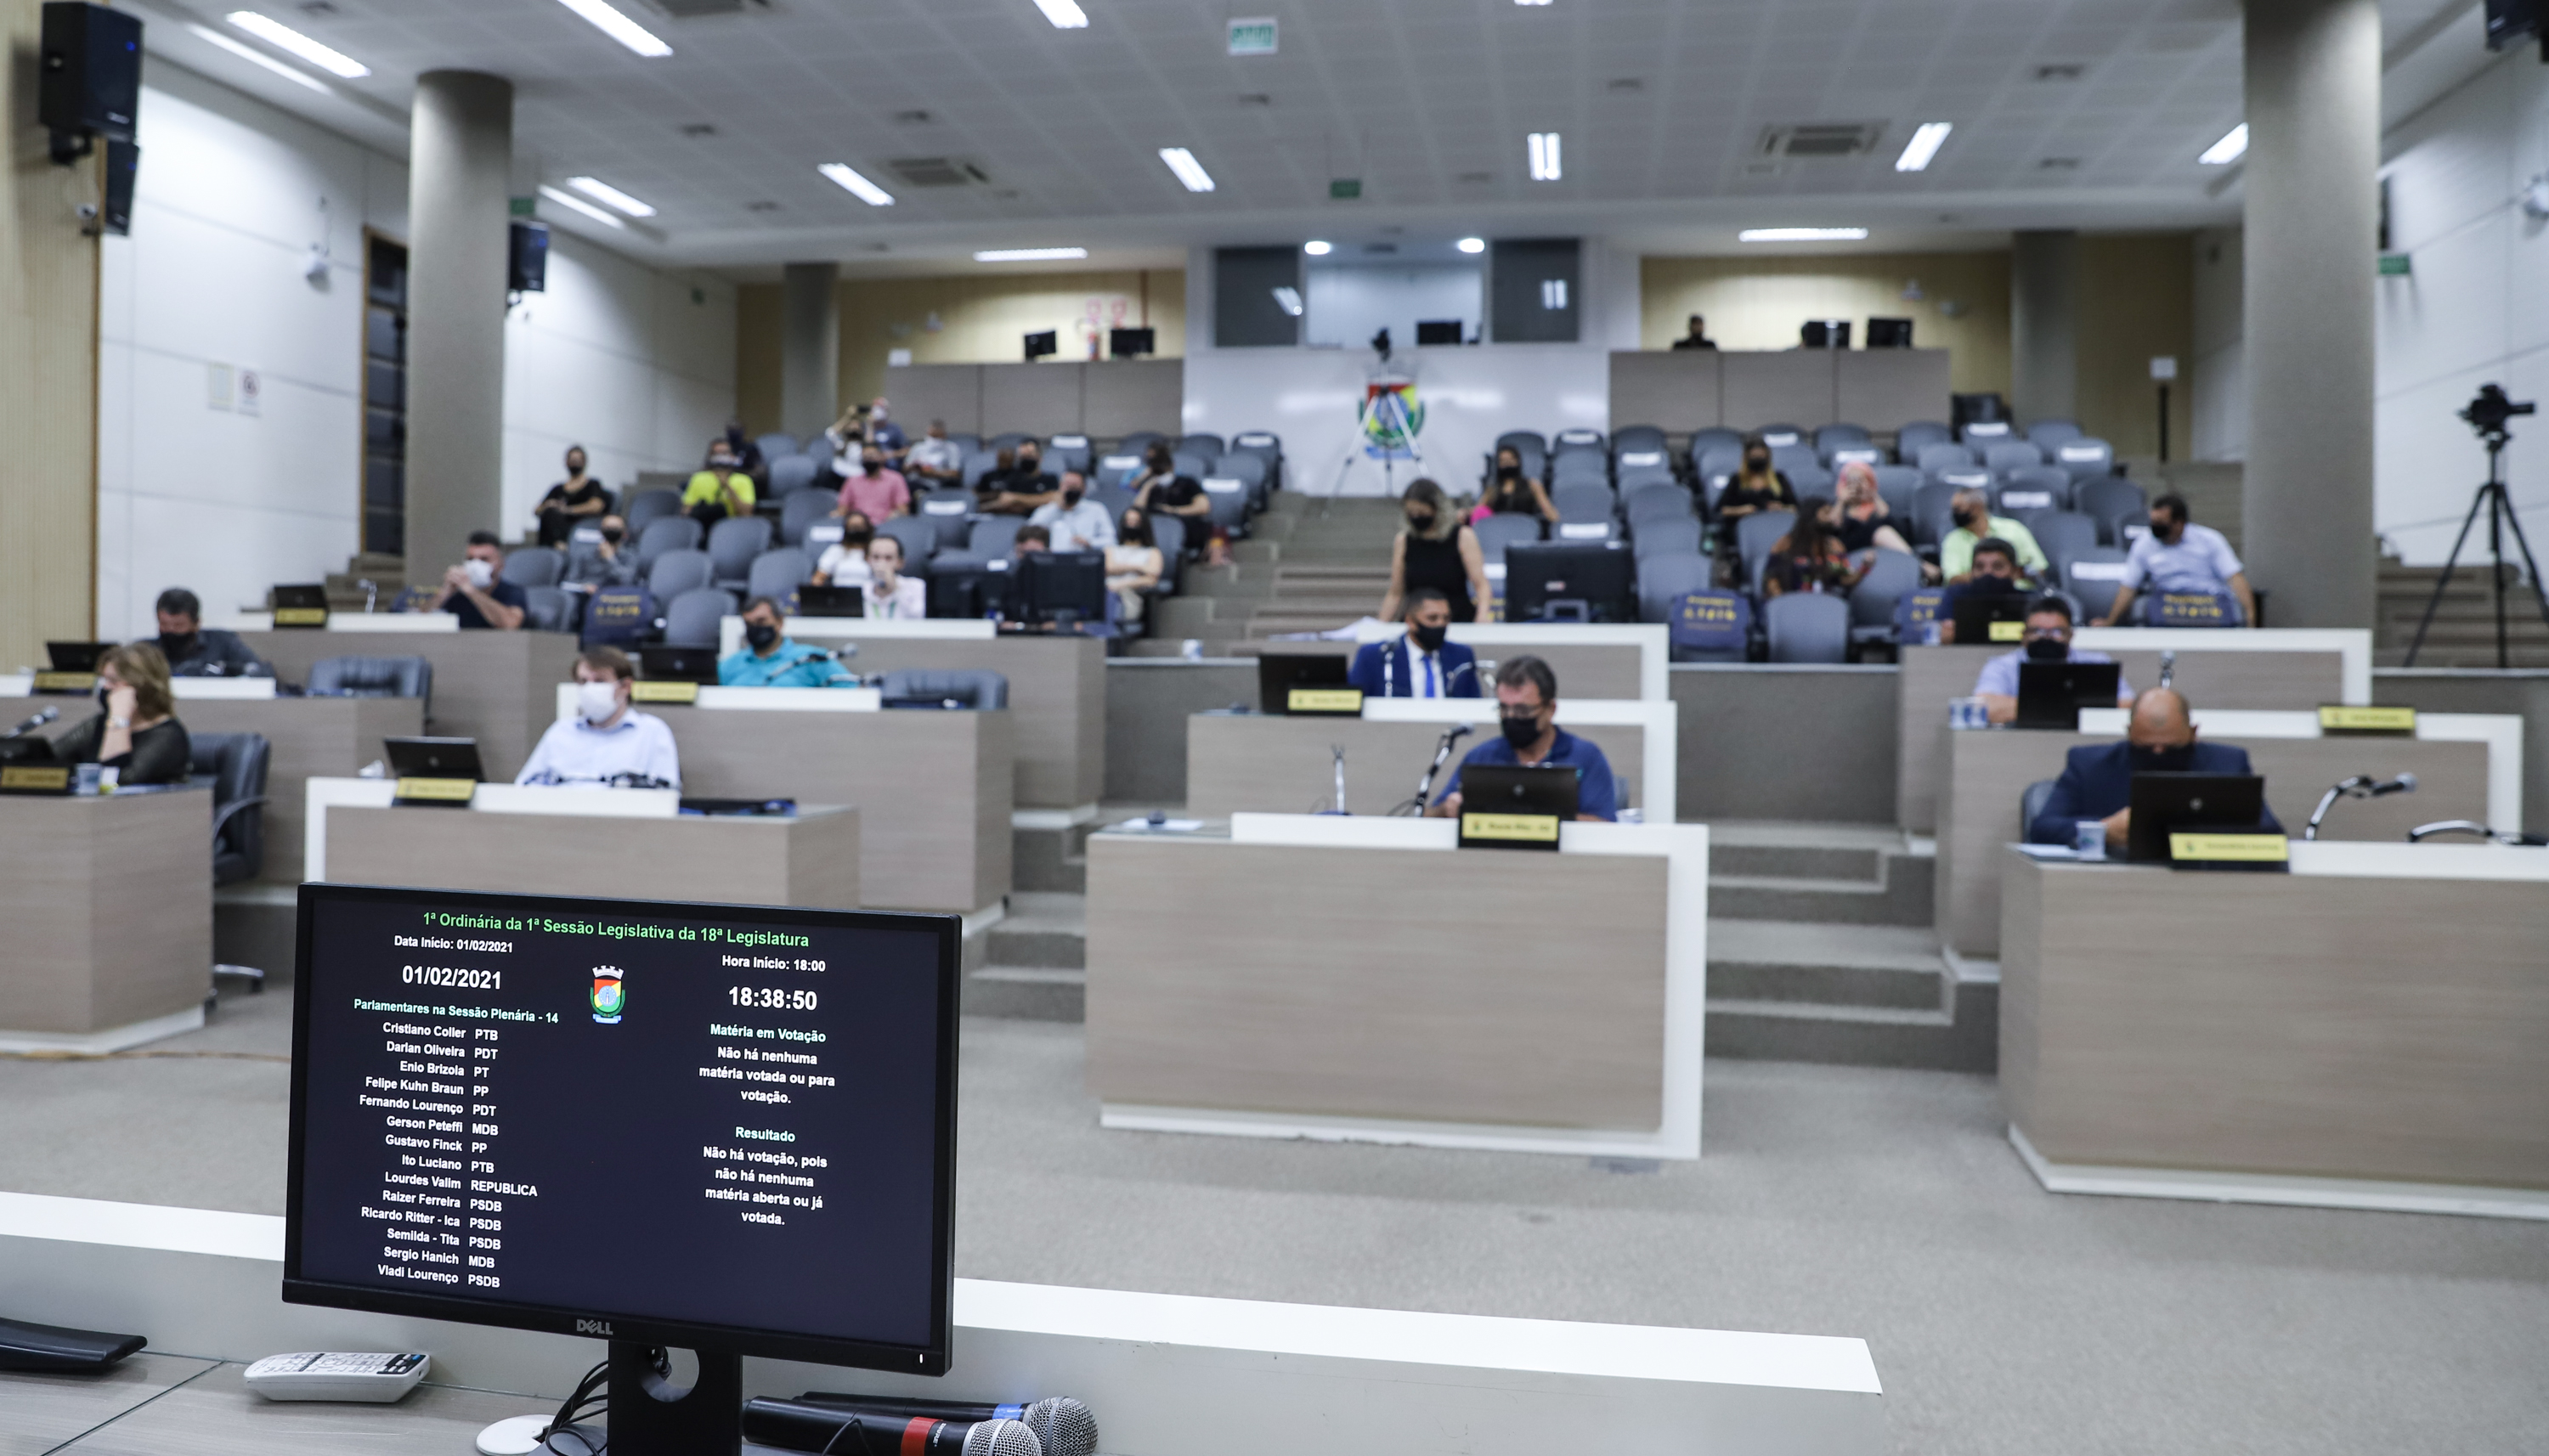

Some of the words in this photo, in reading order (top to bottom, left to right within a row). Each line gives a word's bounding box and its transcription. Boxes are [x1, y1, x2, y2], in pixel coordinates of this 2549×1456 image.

[424, 912, 436, 924] 1ª
[440, 913, 501, 928] Ordinária
[506, 917, 522, 930] da
[527, 918, 540, 931] 1ª
[544, 919, 594, 934] Sessão
[598, 922, 674, 939] Legislativa
[679, 927, 695, 940] da
[701, 928, 722, 941] 18ª
[727, 929, 808, 946] Legislatura
[394, 935, 418, 947] Data
[421, 936, 454, 949] Início:
[457, 940, 512, 952] 01/02/2021
[722, 955, 750, 968] Hora
[754, 957, 789, 969] Início:
[794, 959, 826, 972] 18:00
[403, 966, 500, 989] 01/02/2021
[729, 986, 817, 1010] 18:38:50
[354, 999, 429, 1013] Parlamentares
[432, 1007, 445, 1015] na
[449, 1006, 488, 1018] Sessão
[491, 1008, 534, 1021] Plenária
[545, 1013, 558, 1023] 14
[383, 1022, 431, 1036] Cristiano
[433, 1026, 466, 1038] Coller
[475, 1029, 498, 1041] PTB
[710, 1024, 753, 1037] Matéria
[756, 1030, 774, 1039] em
[778, 1029, 826, 1043] Votação
[387, 1041, 421, 1053] Darlan
[424, 1044, 465, 1057] Oliveira
[475, 1047, 498, 1059] PDT
[718, 1047, 741, 1058] Não
[744, 1048, 758, 1060] há
[762, 1052, 817, 1064] nenhuma
[400, 1061, 424, 1072] Enio
[427, 1063, 464, 1075] Brizola
[474, 1066, 489, 1078] PT
[699, 1066, 743, 1080] matéria
[746, 1070, 786, 1082] votada
[789, 1075, 805, 1084] ou
[808, 1075, 834, 1087] para
[365, 1076, 398, 1091] Felipe
[400, 1080, 428, 1092] Kuhn
[432, 1082, 464, 1095] Braun
[473, 1086, 489, 1097] PP
[741, 1090, 791, 1104] votação.
[359, 1095, 410, 1109] Fernando
[413, 1099, 463, 1115] Lourenço
[473, 1104, 496, 1116] PDT
[387, 1115, 426, 1129] Gerson
[428, 1120, 462, 1132] Peteffi
[472, 1123, 498, 1136] MDB
[736, 1126, 795, 1142] Resultado
[386, 1134, 430, 1148] Gustavo
[433, 1138, 462, 1151] Finck
[472, 1142, 487, 1153] PP
[402, 1154, 415, 1165] Ito
[419, 1156, 461, 1170] Luciano
[472, 1161, 494, 1173] PTB
[704, 1146, 726, 1159] Não
[730, 1148, 744, 1160] há
[747, 1151, 798, 1167] votação,
[801, 1156, 828, 1168] pois
[385, 1171, 429, 1186] Lourdes
[432, 1176, 461, 1189] Valim
[471, 1180, 538, 1196] REPUBLICA
[715, 1167, 738, 1180] não
[741, 1169, 755, 1182] há
[759, 1173, 814, 1187] nenhuma
[383, 1190, 416, 1203] Raizer
[419, 1194, 461, 1208] Ferreira
[470, 1199, 502, 1212] PSDB
[705, 1188, 749, 1201] matéria
[753, 1192, 790, 1205] aberta
[794, 1197, 809, 1207] ou
[811, 1196, 822, 1211] já
[361, 1206, 403, 1221] Ricardo
[405, 1211, 435, 1224] Ritter
[444, 1215, 460, 1227] Ica
[470, 1217, 501, 1231] PSDB
[742, 1211, 785, 1225] votada.
[387, 1228, 429, 1242] Semilda
[440, 1233, 460, 1245] Tita
[469, 1237, 500, 1250] PSDB
[384, 1246, 419, 1261] Sergio
[421, 1250, 459, 1264] Hanich
[469, 1256, 495, 1268] MDB
[378, 1264, 404, 1277] Vladi
[408, 1267, 459, 1284] Lourenço
[468, 1274, 500, 1288] PSDB
[577, 1319, 613, 1335] DELL
